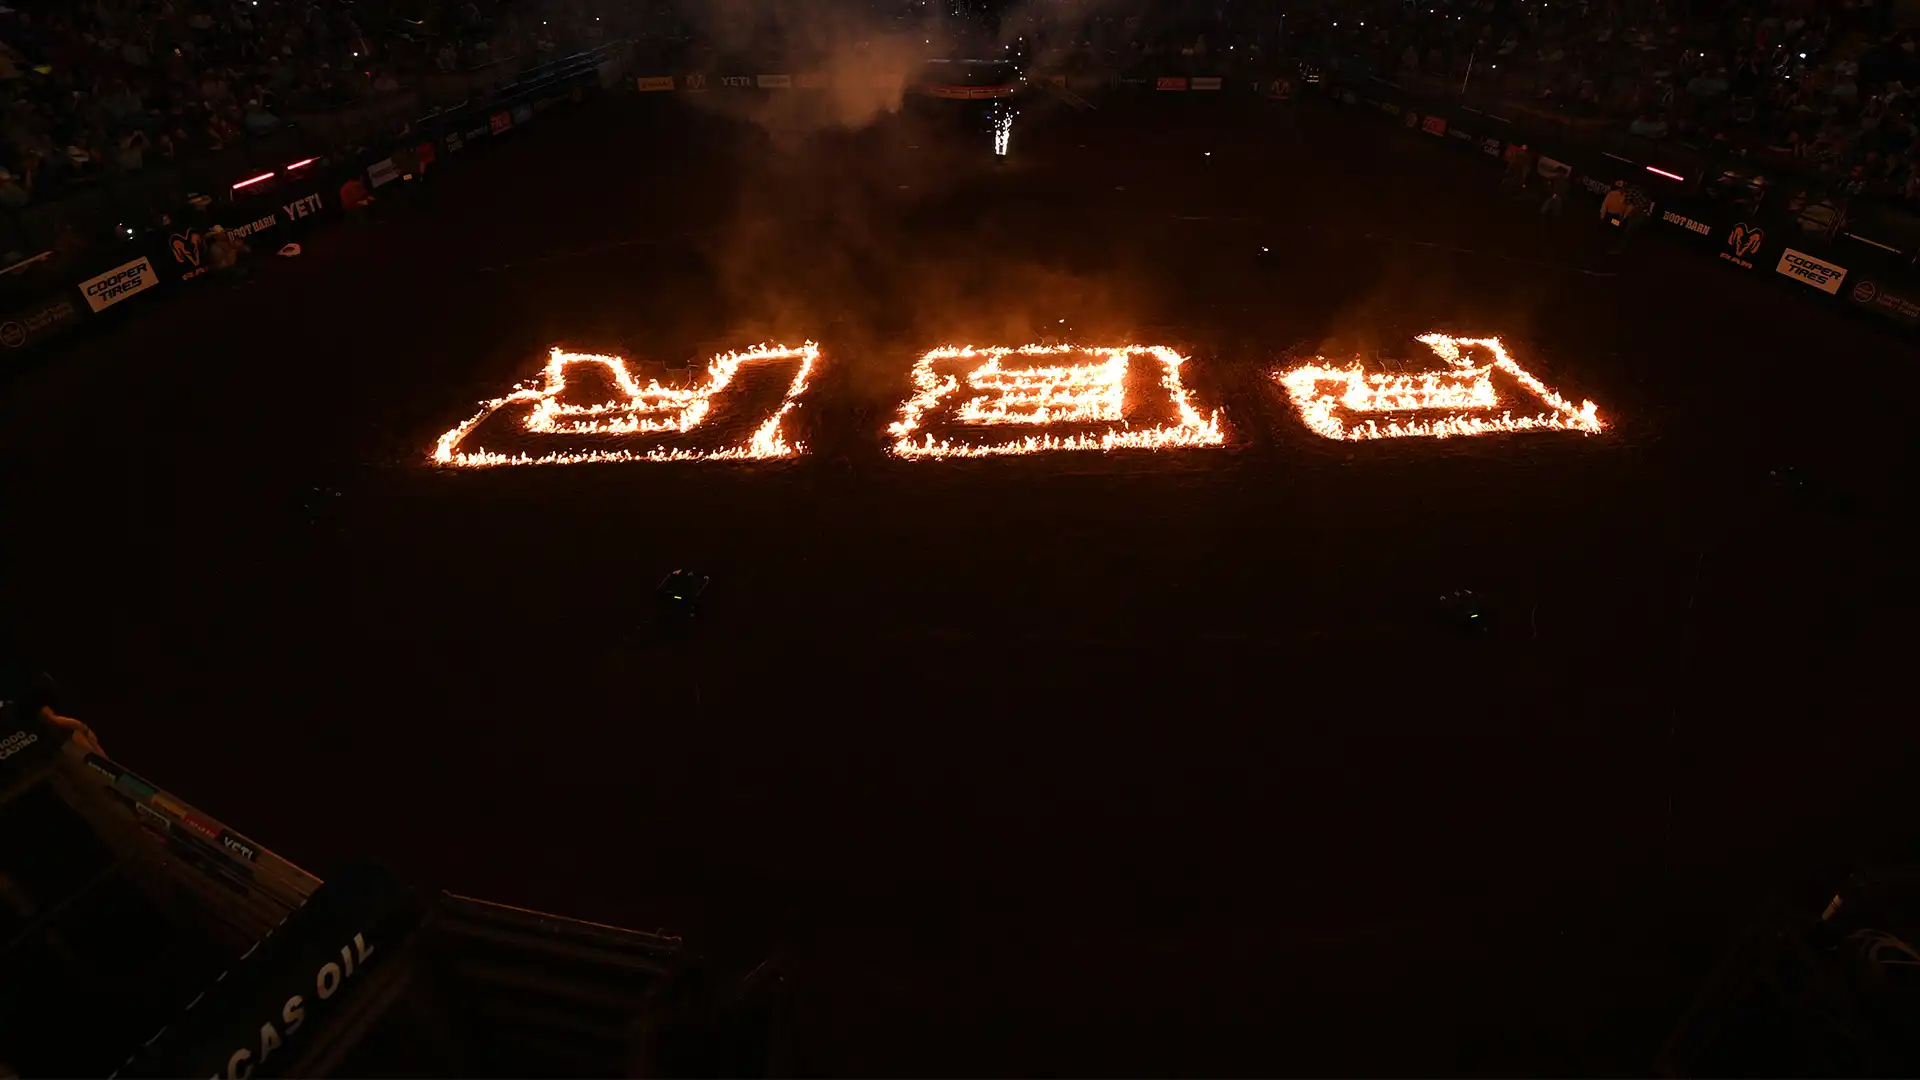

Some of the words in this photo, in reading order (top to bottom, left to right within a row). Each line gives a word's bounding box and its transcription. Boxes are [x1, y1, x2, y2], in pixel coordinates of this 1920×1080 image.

[720, 75, 751, 87] YETI
[282, 192, 324, 221] YETI
[250, 212, 277, 233] BARN
[1662, 210, 1688, 226] BOOT
[1685, 218, 1712, 236] BARN
[86, 262, 148, 296] COOPER
[1784, 253, 1842, 281] COOPER
[1788, 264, 1828, 285] TIRES
[97, 277, 142, 302] TIRES
[223, 836, 254, 860] YETI
[209, 994, 306, 1080] CAS
[315, 931, 375, 1000] OIL
